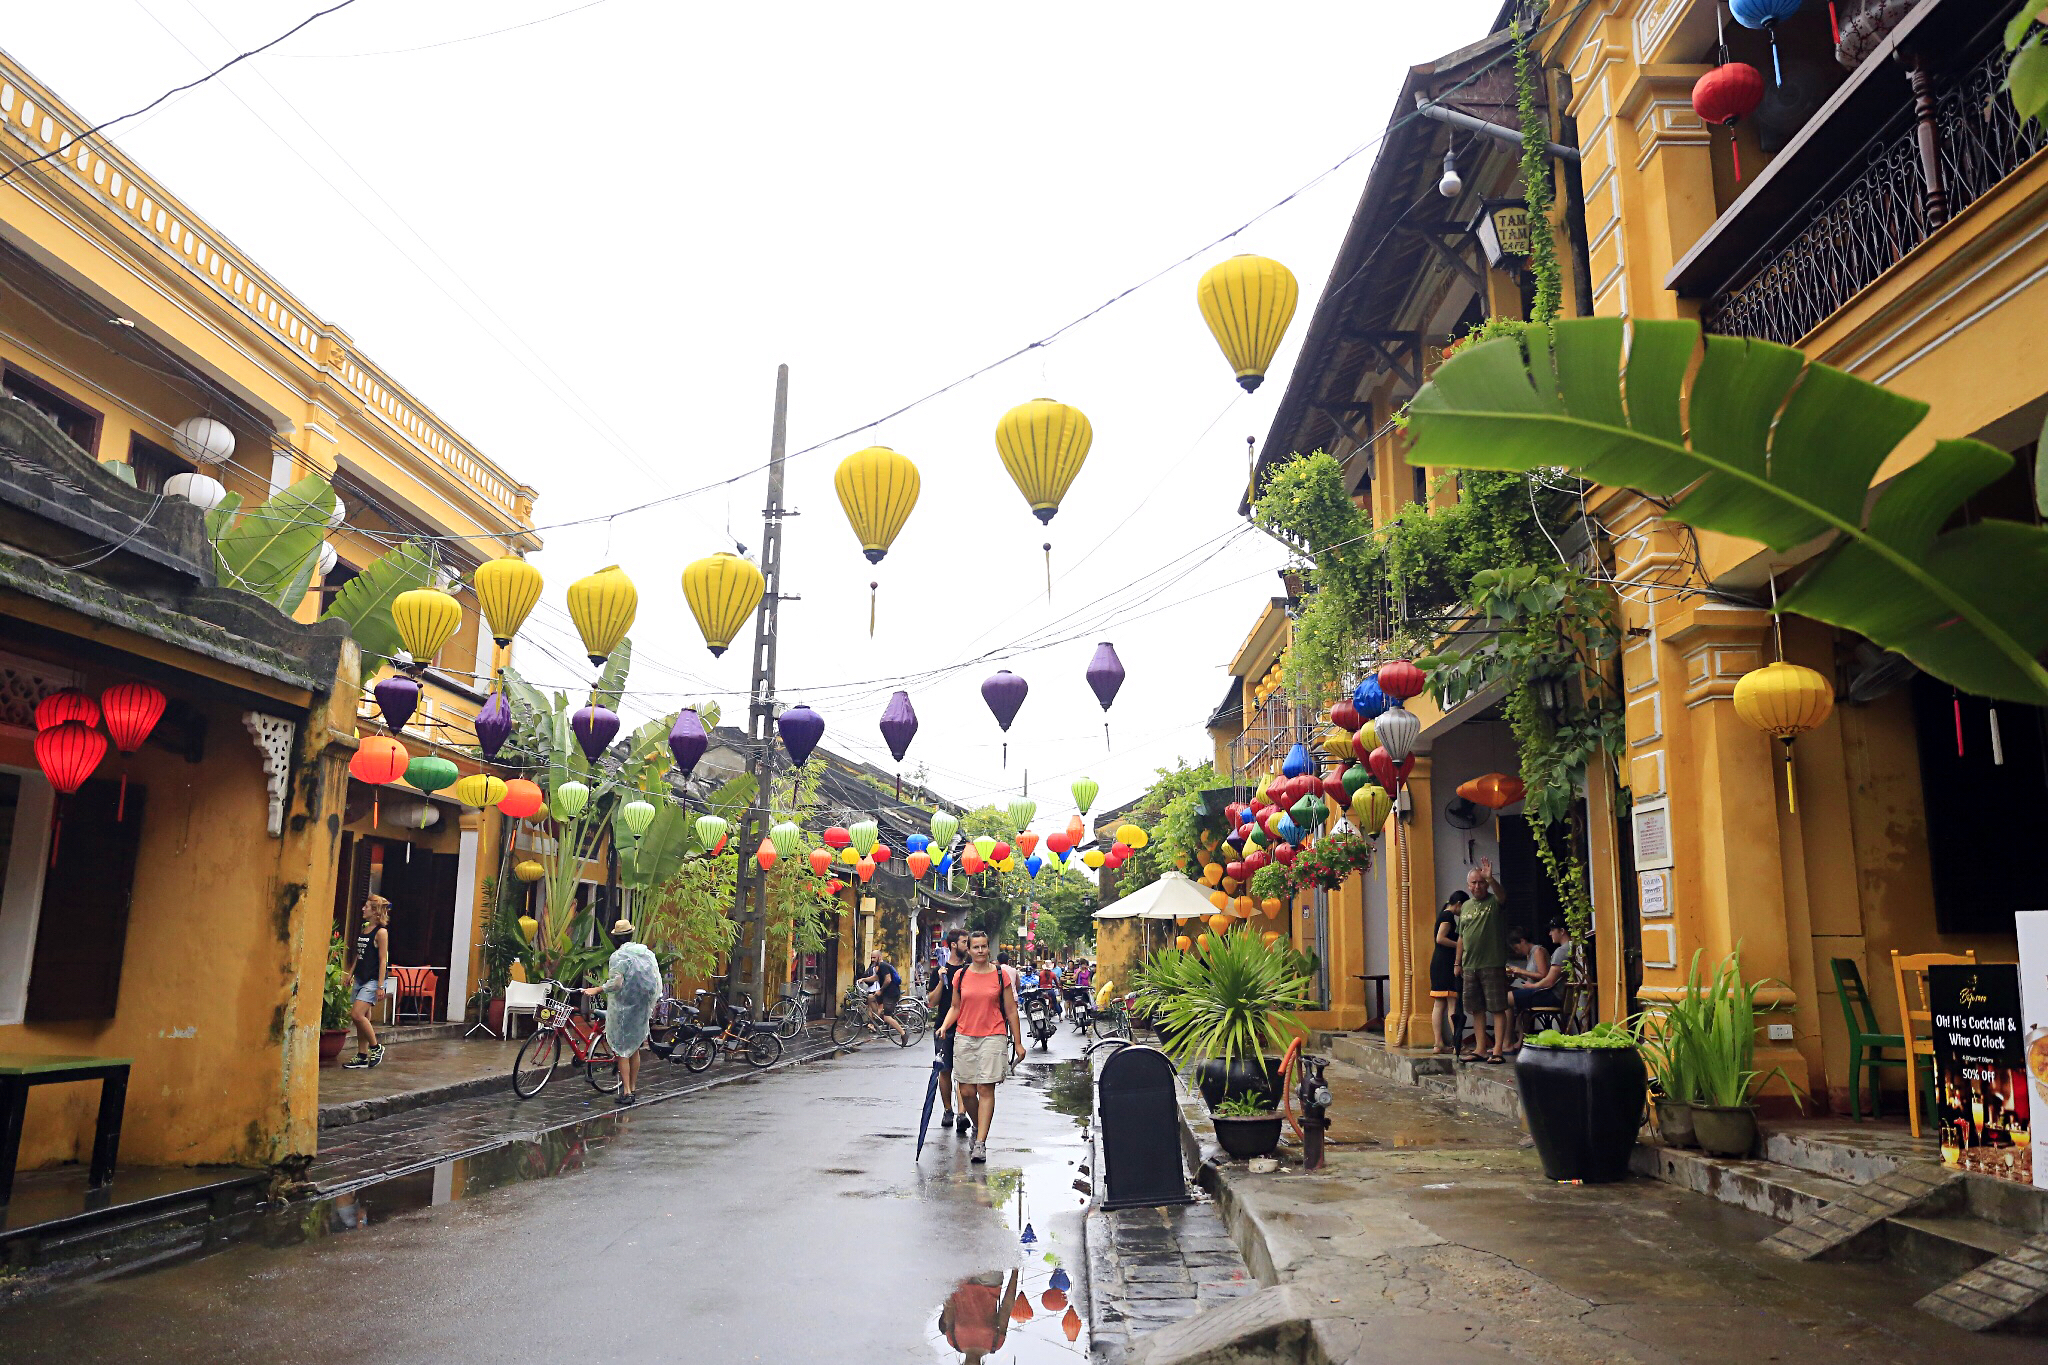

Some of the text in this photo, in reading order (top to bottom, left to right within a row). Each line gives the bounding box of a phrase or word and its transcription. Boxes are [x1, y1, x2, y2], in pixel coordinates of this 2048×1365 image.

[1499, 214, 1527, 226] TAM
[1499, 228, 1528, 240] TAM
[1501, 242, 1525, 251] CAFE
[1936, 1014, 2017, 1032] Oh! It's Cocktail &
[1948, 1033, 2006, 1049] Wine O'clock
[1962, 1068, 1995, 1083] 50% OFF
